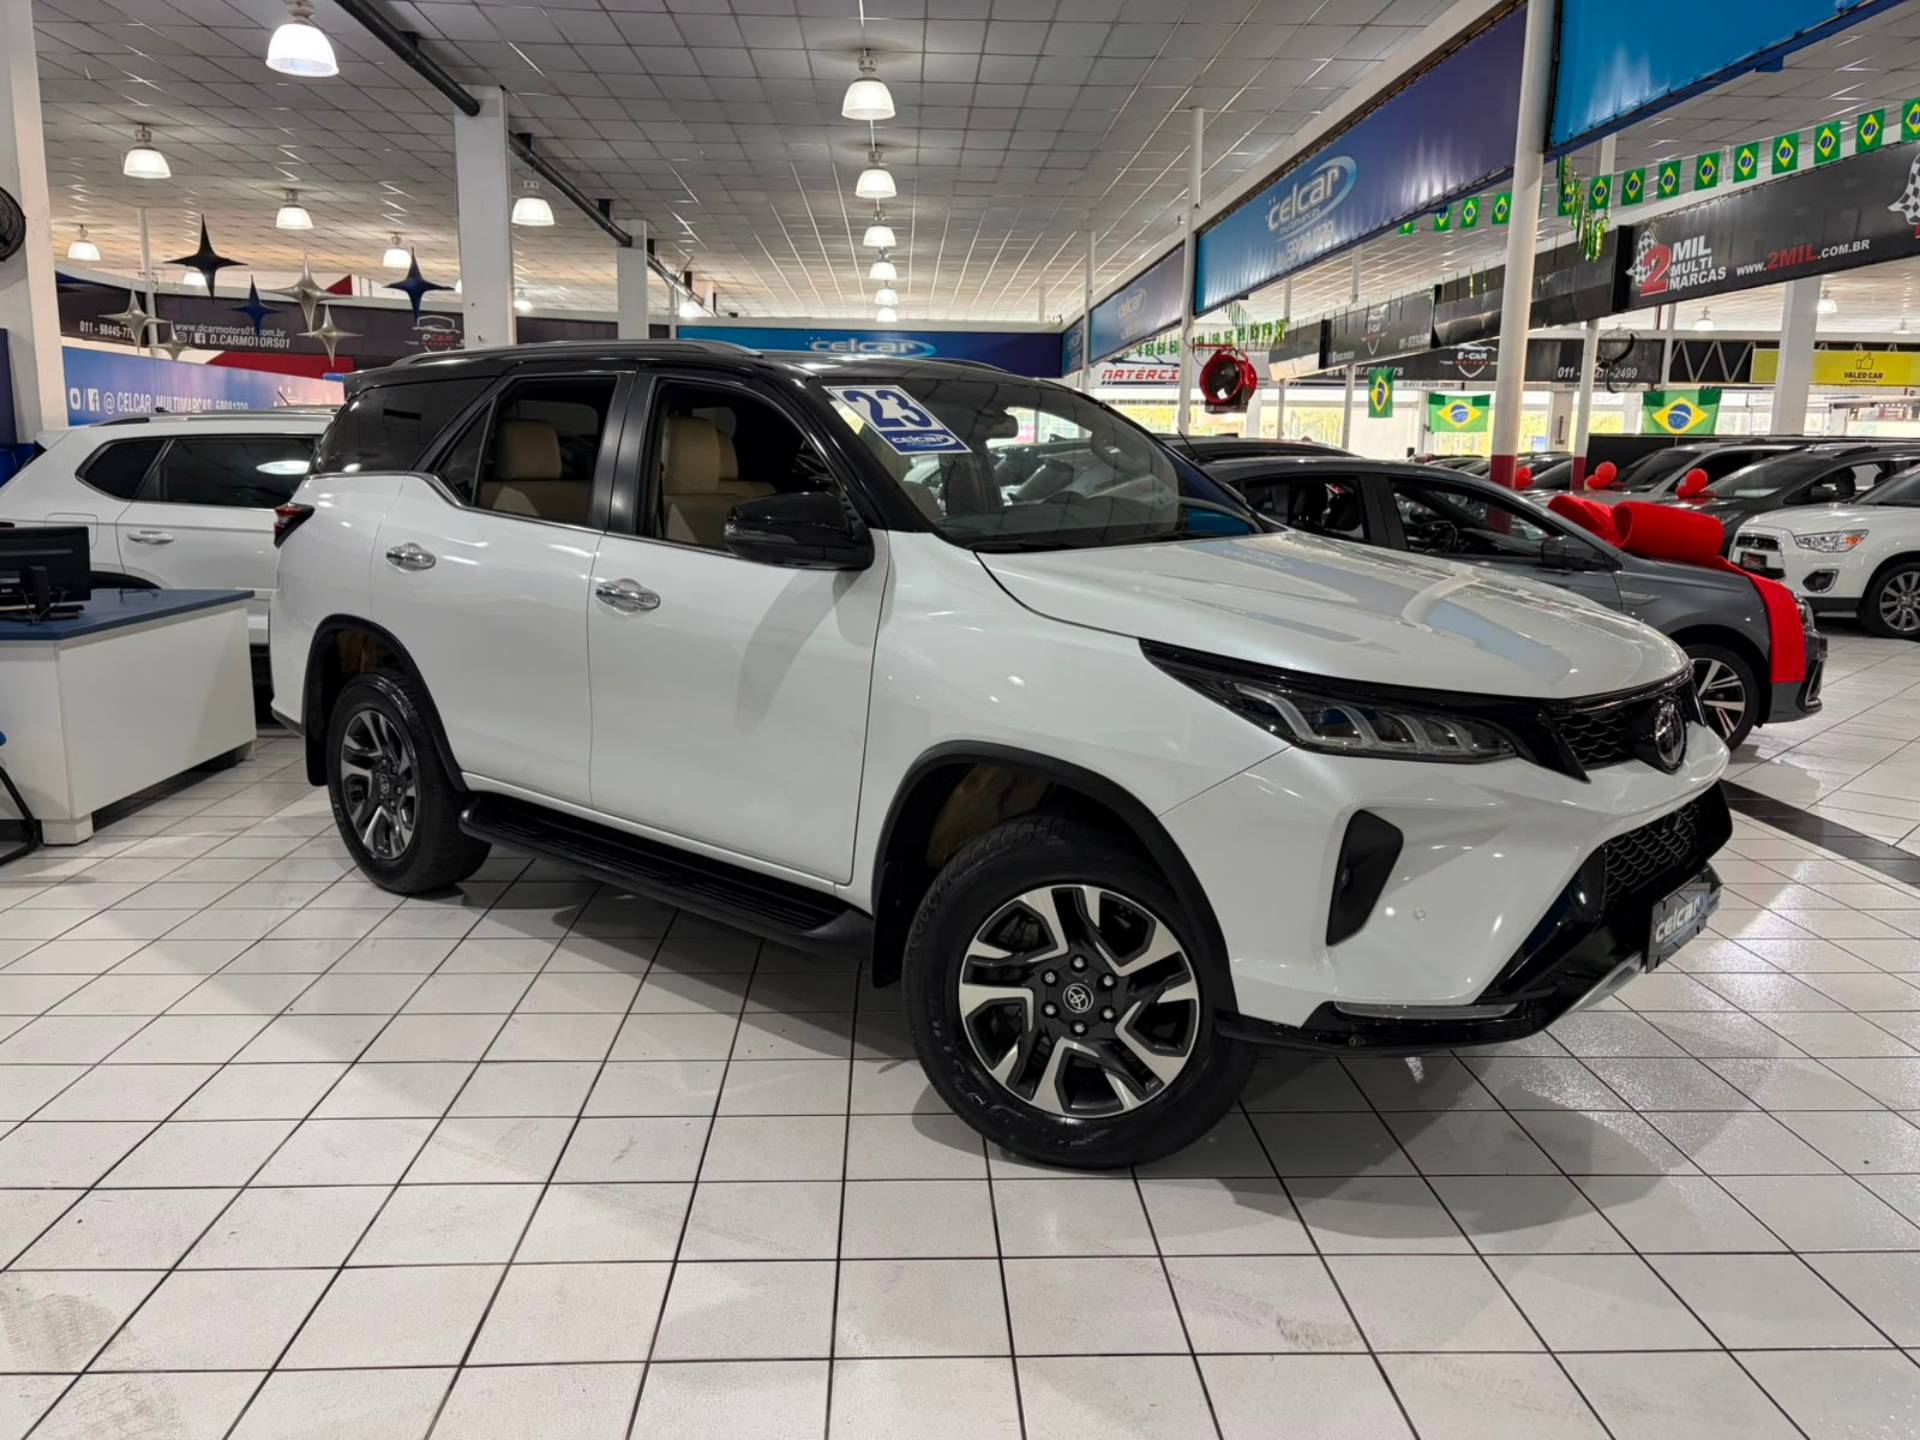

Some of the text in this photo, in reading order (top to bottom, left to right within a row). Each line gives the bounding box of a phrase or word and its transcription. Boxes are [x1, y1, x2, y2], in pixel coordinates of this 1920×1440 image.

[1267, 167, 1339, 232] celcar
[1640, 235, 1712, 297] 2 MIL
[1669, 256, 1713, 278] MULTI
[1669, 266, 1727, 291] MARCAS
[79, 320, 94, 334] 011
[808, 337, 907, 353] celcar
[1102, 367, 1179, 380] NATÉRCI
[1557, 366, 1576, 379] 011
[842, 389, 933, 428] 23
[1655, 895, 1701, 943] celcar
